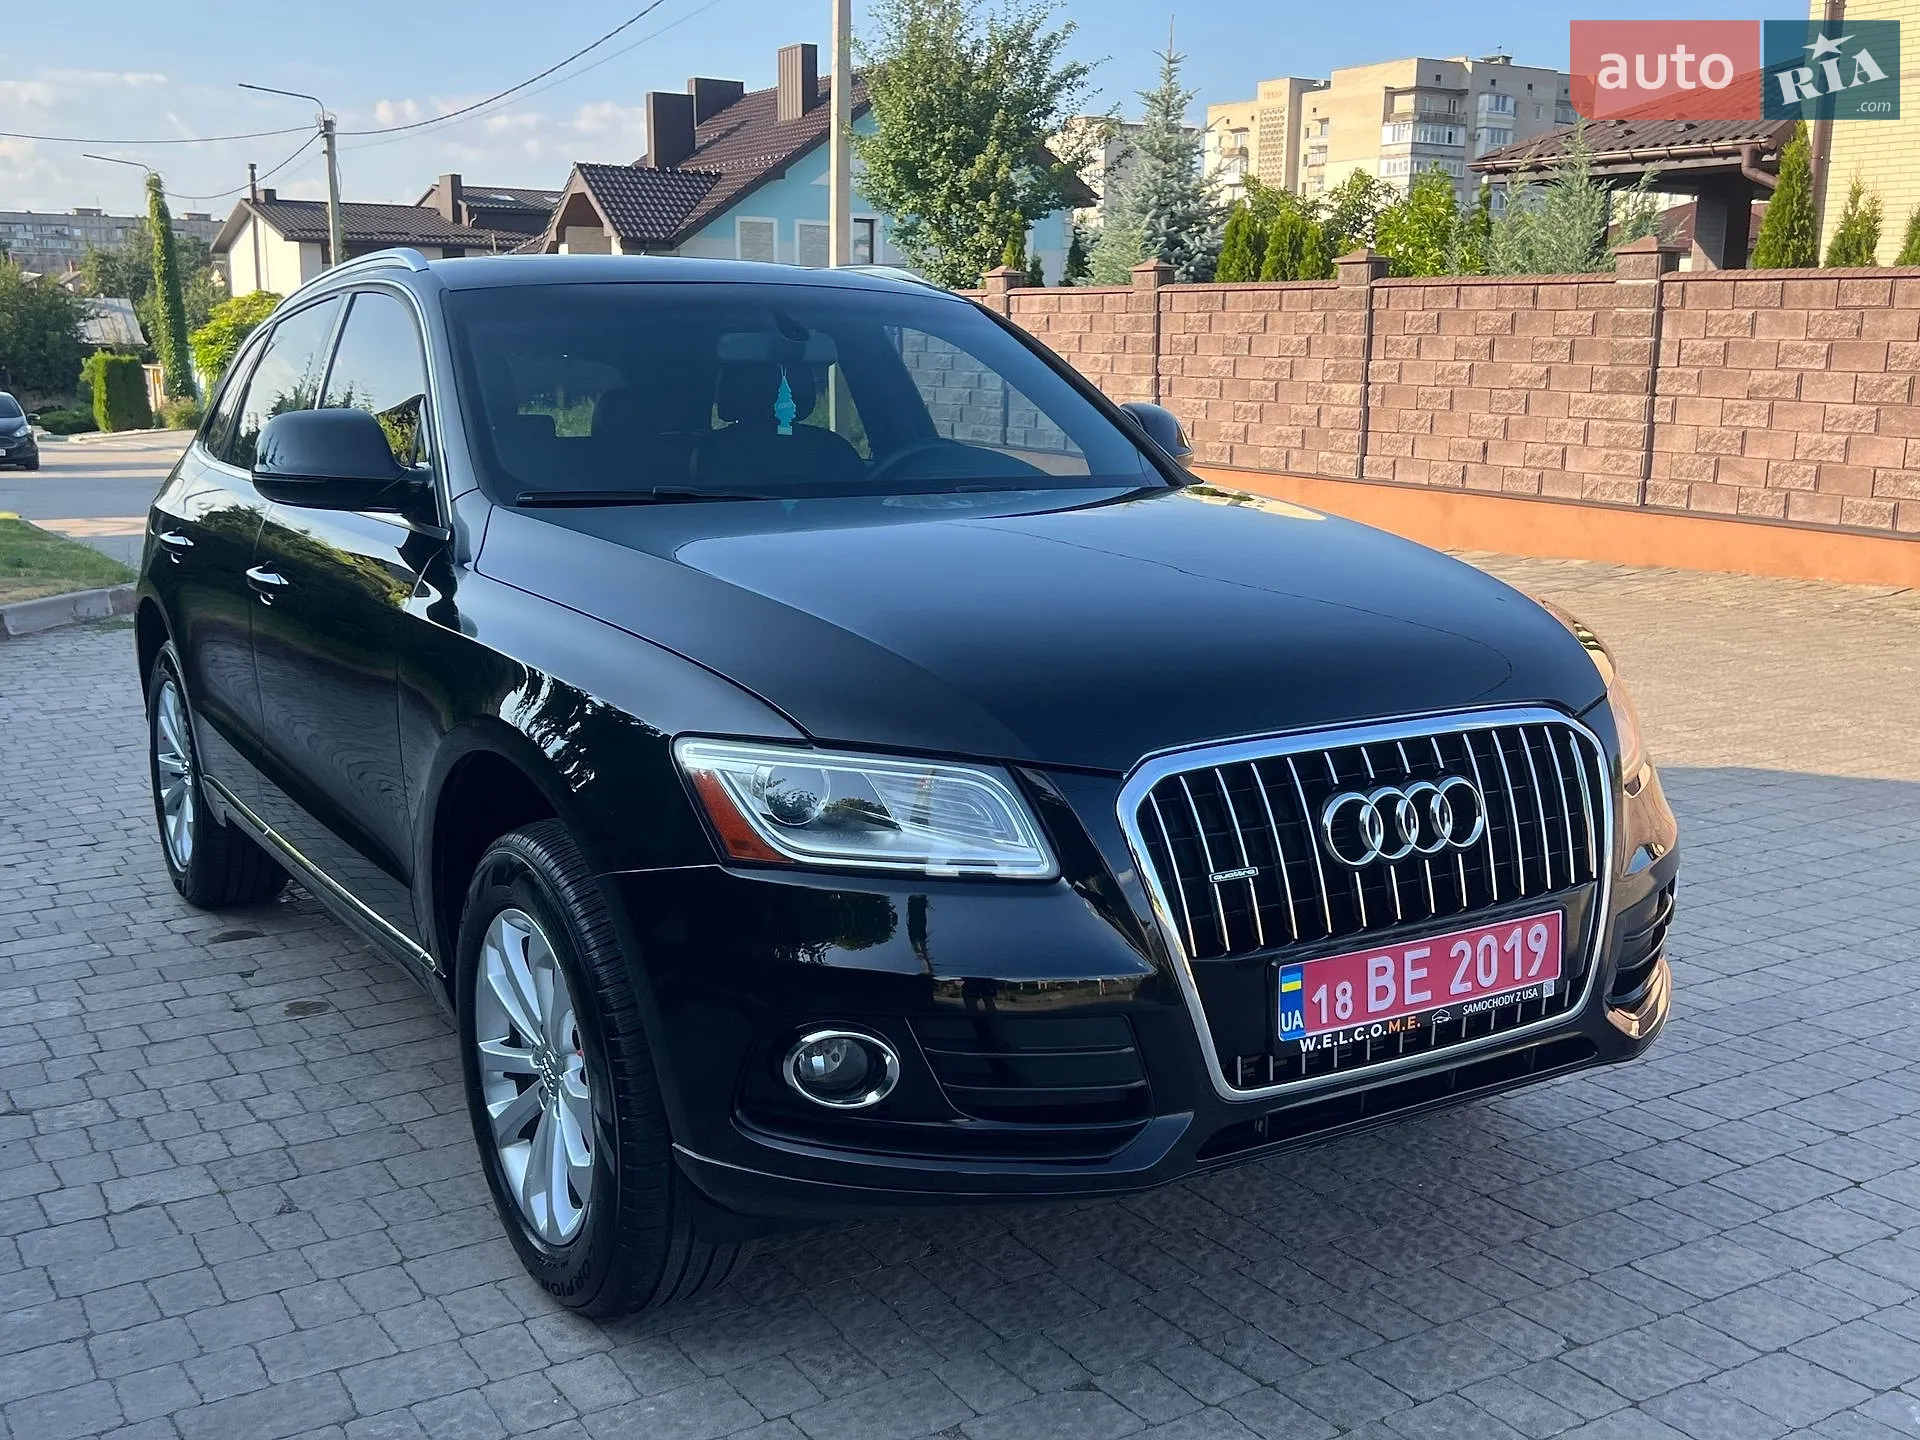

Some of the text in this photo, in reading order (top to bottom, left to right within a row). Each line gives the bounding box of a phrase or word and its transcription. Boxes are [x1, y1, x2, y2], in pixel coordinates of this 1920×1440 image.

[1213, 869, 1255, 881] quattro
[1312, 923, 1548, 1024] 18 BE 2019
[1462, 987, 1539, 1015] SAMOCHODY Z USA
[1281, 1009, 1304, 1032] UA
